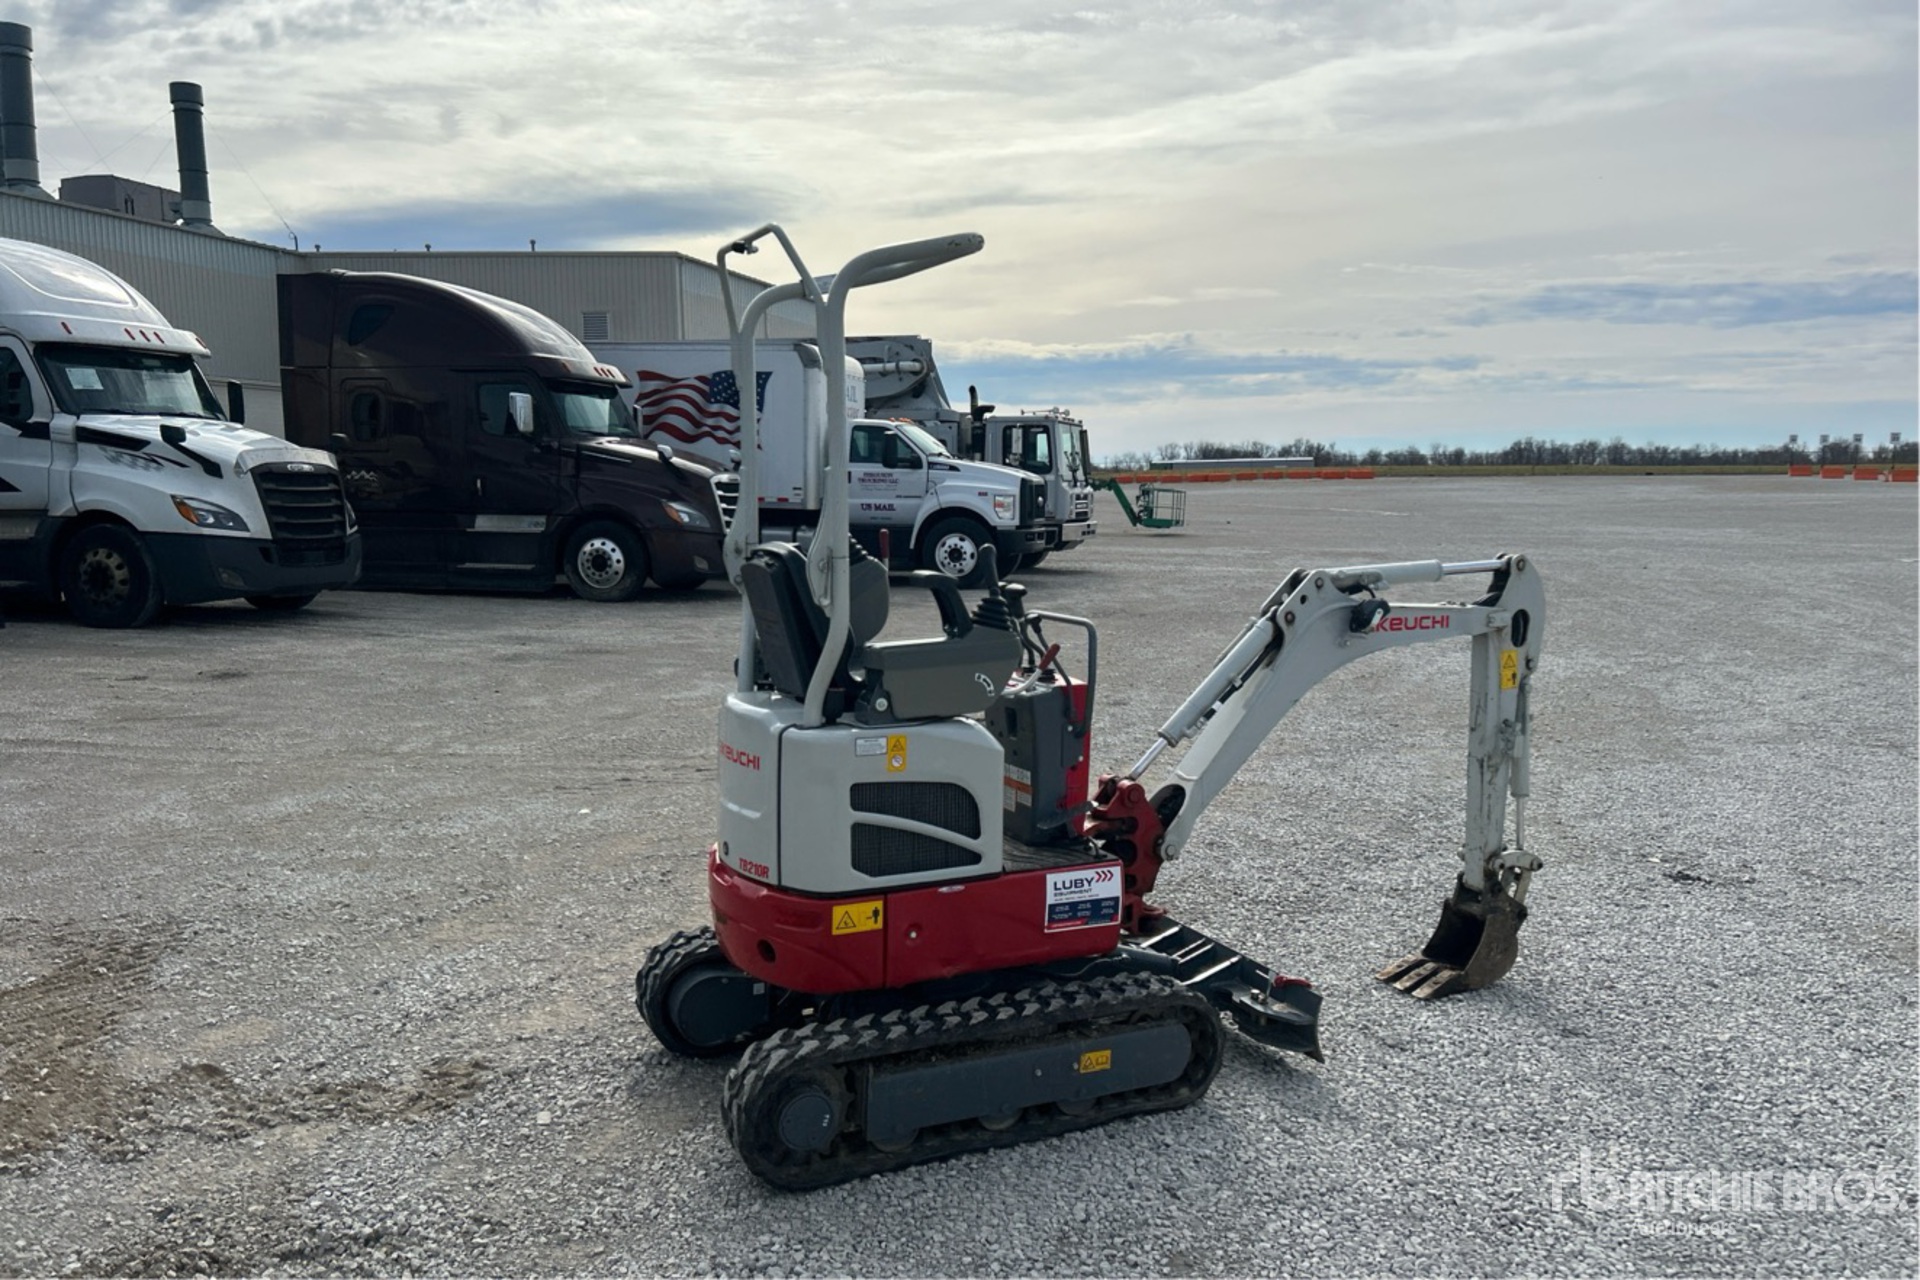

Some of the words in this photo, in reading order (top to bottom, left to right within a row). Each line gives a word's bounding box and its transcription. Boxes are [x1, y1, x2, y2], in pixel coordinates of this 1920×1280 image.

[861, 503, 872, 511] US
[874, 503, 896, 511] MAIL
[1375, 615, 1450, 632] KEUCHI
[739, 857, 770, 879] TB210R
[1053, 877, 1094, 891] LUBY
